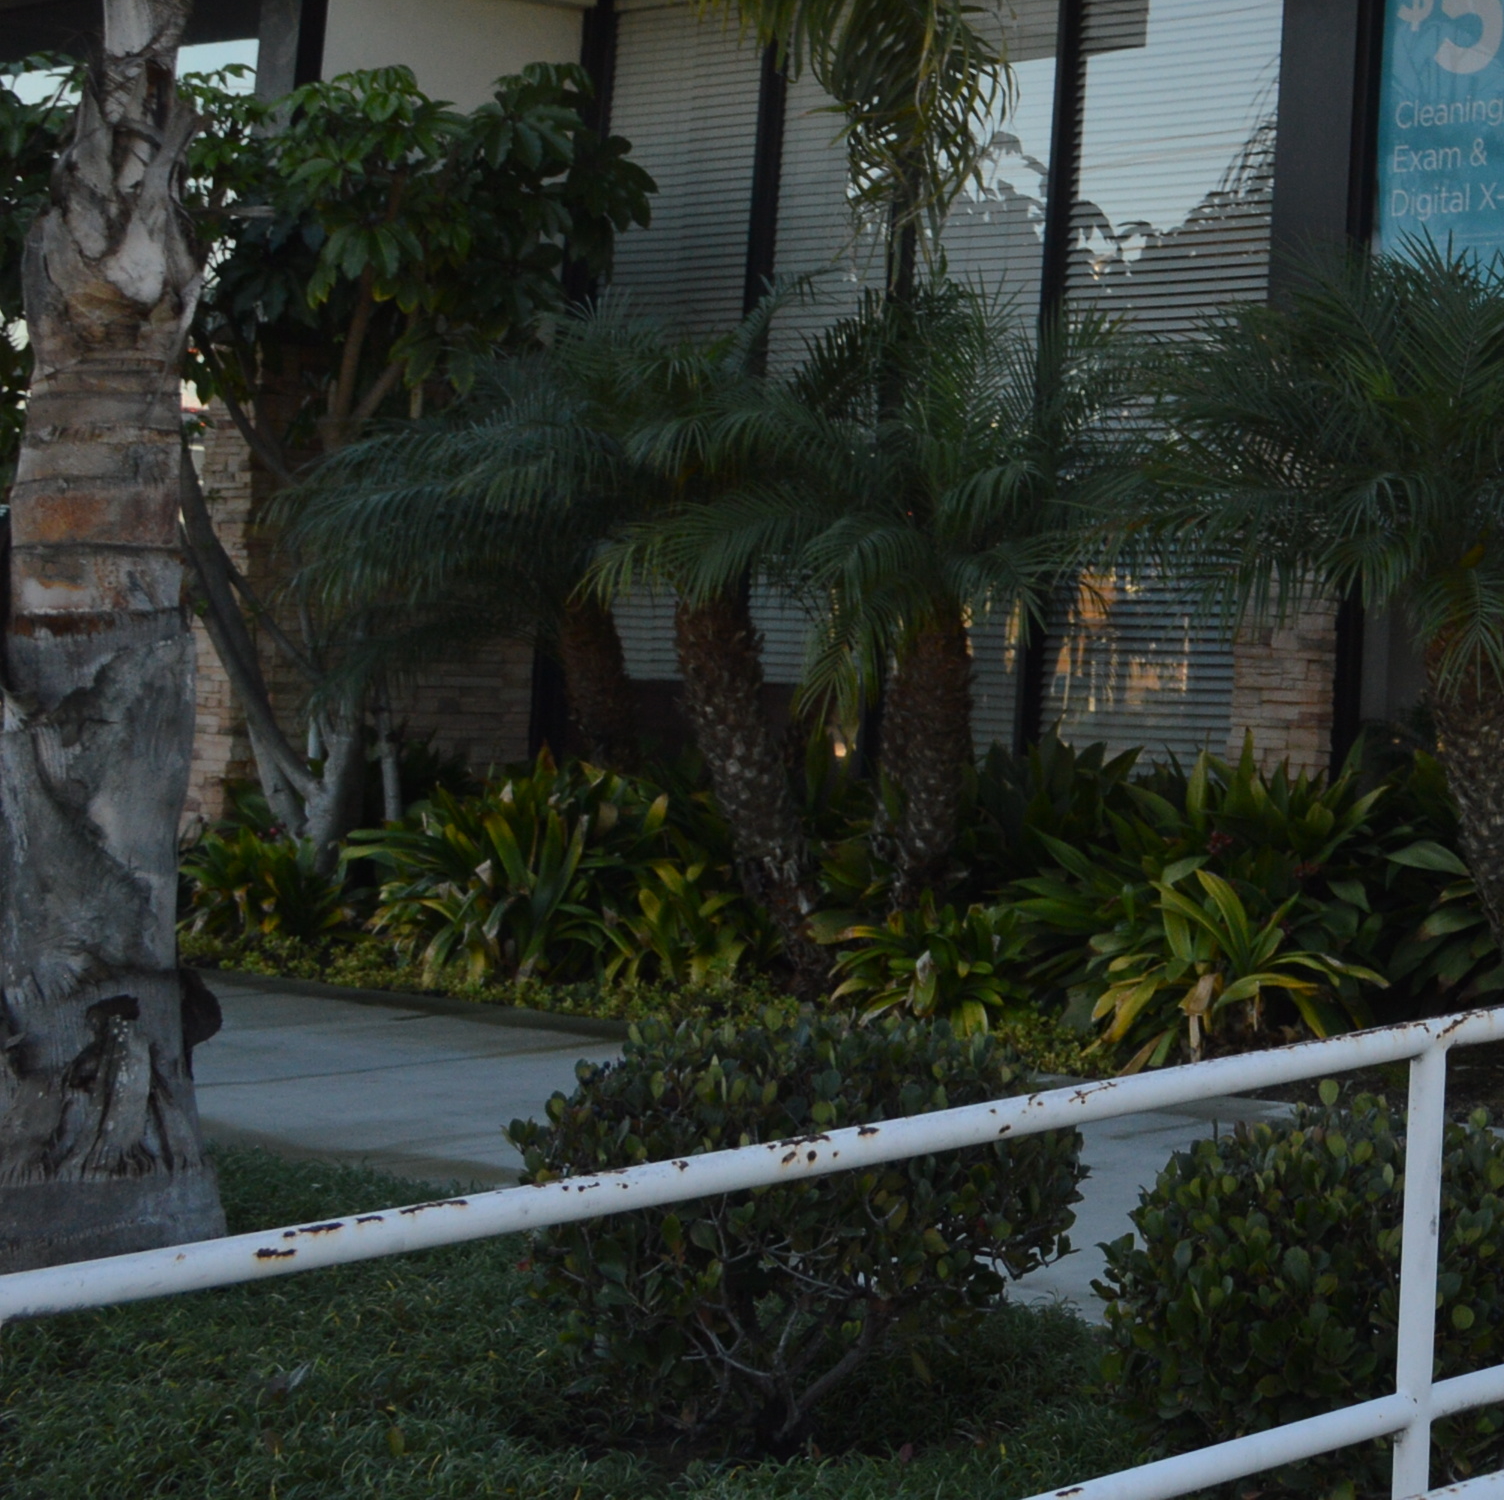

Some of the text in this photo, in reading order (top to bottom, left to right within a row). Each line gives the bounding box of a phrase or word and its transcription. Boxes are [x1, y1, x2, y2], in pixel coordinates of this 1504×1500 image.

[1392, 138, 1487, 175] Exam &
[1390, 182, 1470, 222] Digital
